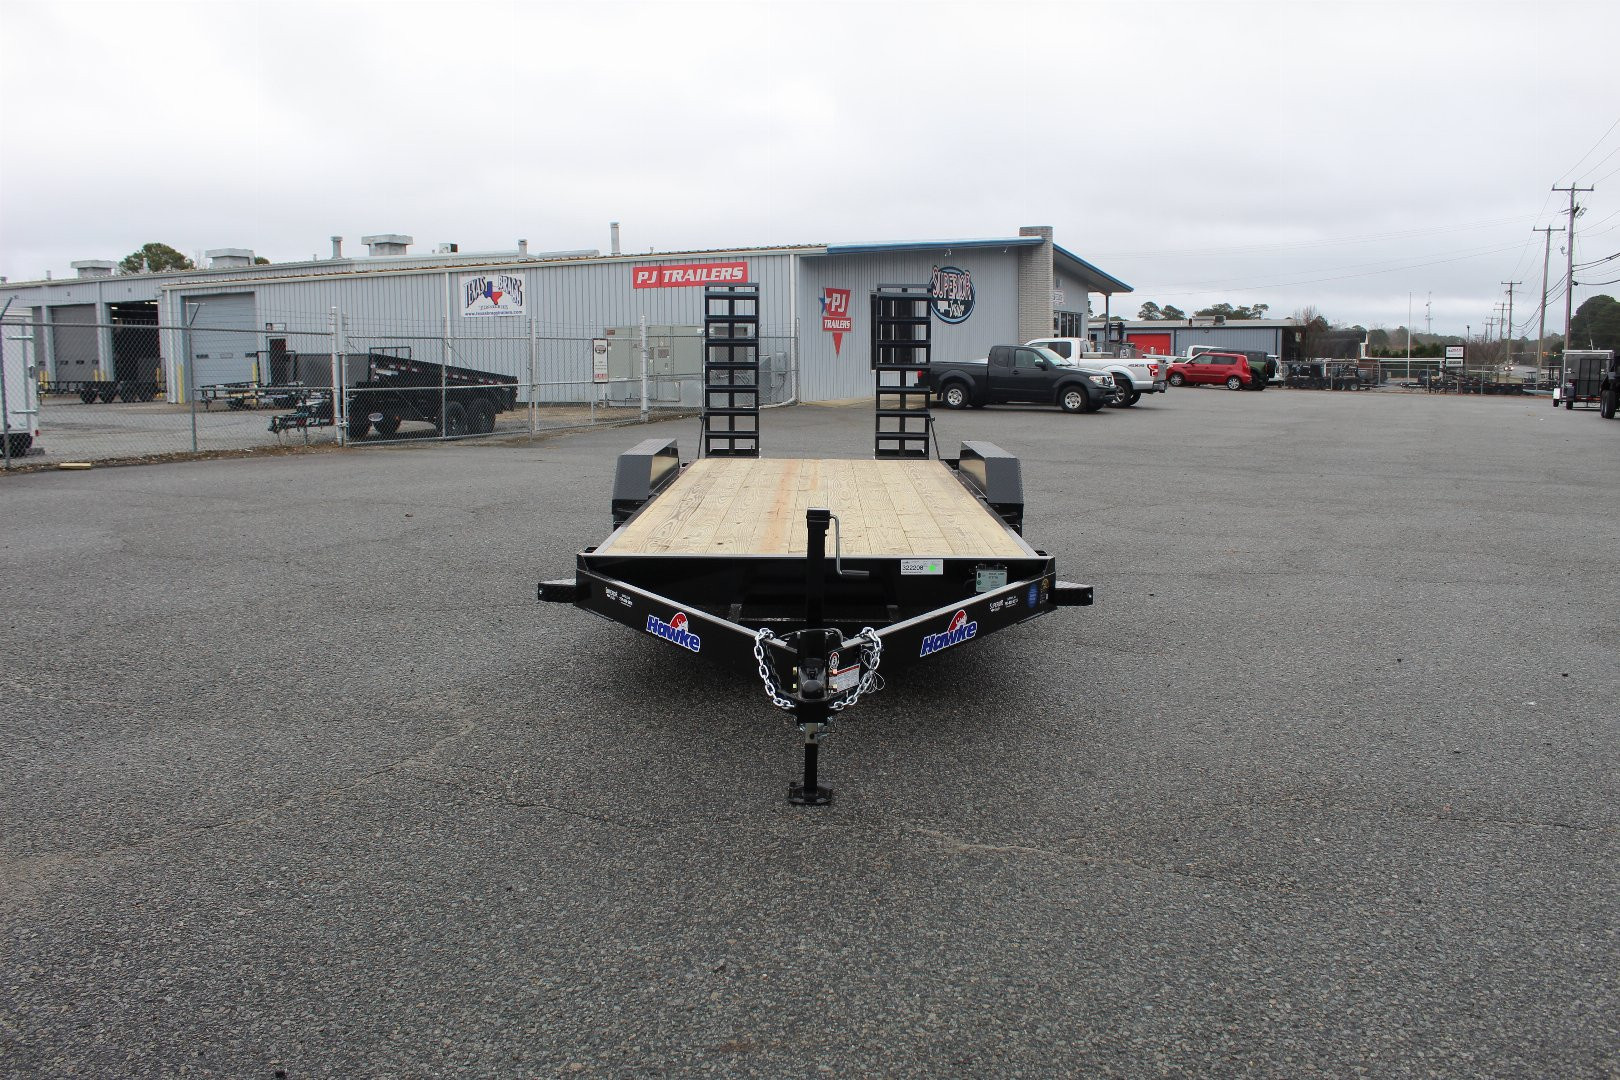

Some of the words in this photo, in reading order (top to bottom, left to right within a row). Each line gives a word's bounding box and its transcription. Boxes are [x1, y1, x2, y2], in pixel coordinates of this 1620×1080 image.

[636, 271, 658, 284] PJ
[662, 266, 744, 283] TRAILERS
[463, 276, 486, 309] TEXAS
[497, 275, 523, 307] BRAGG
[831, 293, 847, 313] PJ
[824, 319, 851, 329] TRAILERS
[645, 614, 701, 653] Hawke
[919, 619, 978, 658] Hawke
